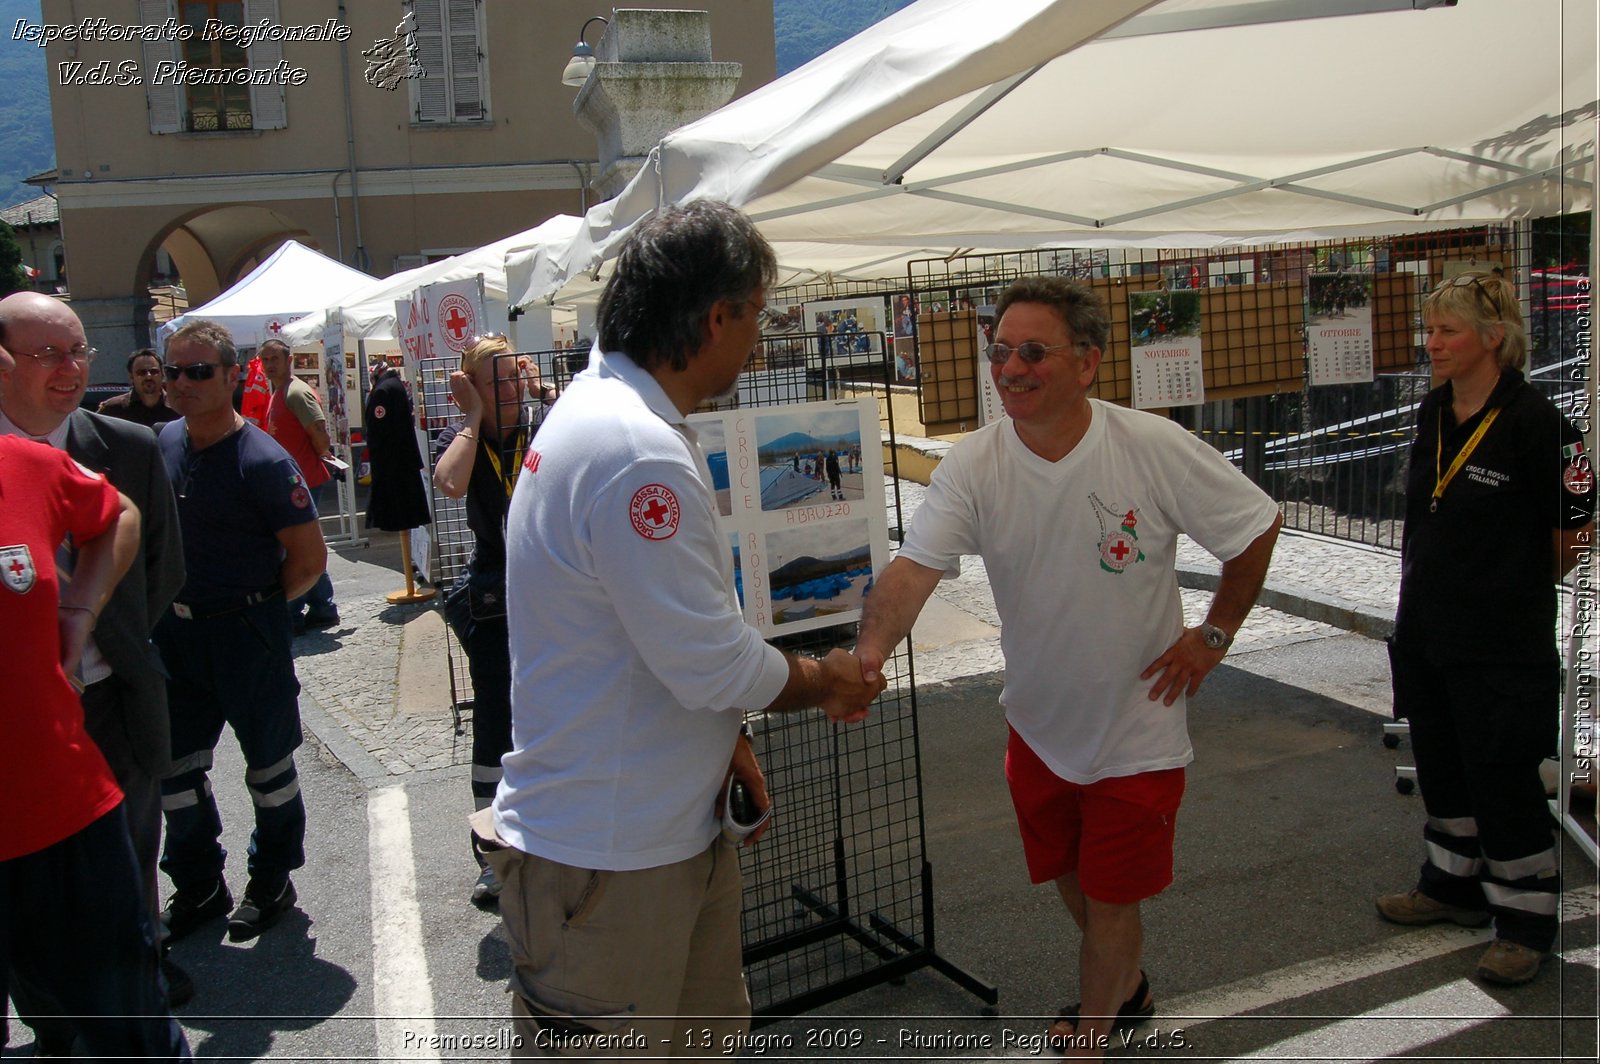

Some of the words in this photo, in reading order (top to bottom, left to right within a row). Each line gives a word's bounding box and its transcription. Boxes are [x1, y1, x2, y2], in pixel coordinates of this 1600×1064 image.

[1320, 328, 1361, 338] OTTOBRE
[1144, 348, 1190, 359] NOVEMBRE
[1465, 465, 1485, 476] CROCE
[1487, 470, 1510, 482] ROSSA
[1468, 474, 1499, 487] ITALIANA
[632, 487, 659, 509] ROSSA
[661, 489, 678, 529] ITALIANA
[786, 503, 851, 524] ABRUZZO
[632, 511, 654, 537] CROCE
